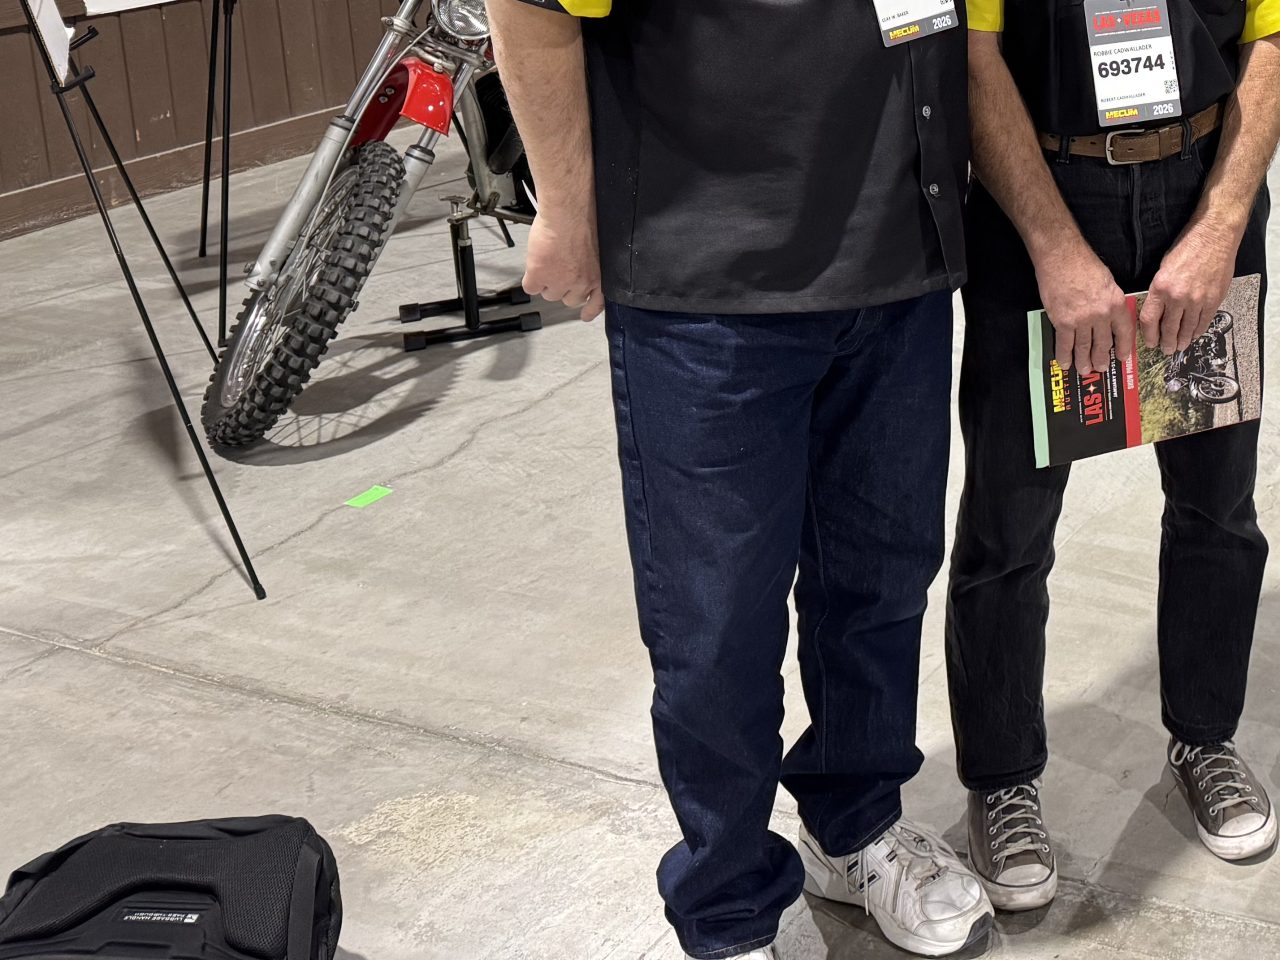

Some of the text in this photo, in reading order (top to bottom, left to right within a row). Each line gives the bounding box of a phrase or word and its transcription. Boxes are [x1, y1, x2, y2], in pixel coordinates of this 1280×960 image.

[889, 15, 952, 40] MECUM 2026
[1094, 48, 1112, 57] ROBBIE
[1098, 54, 1166, 78] 693744
[1105, 103, 1174, 119] MECUM 2026
[1050, 360, 1066, 413] MECUM
[1063, 370, 1071, 410] AUCTIO
[1083, 393, 1104, 426] LAS
